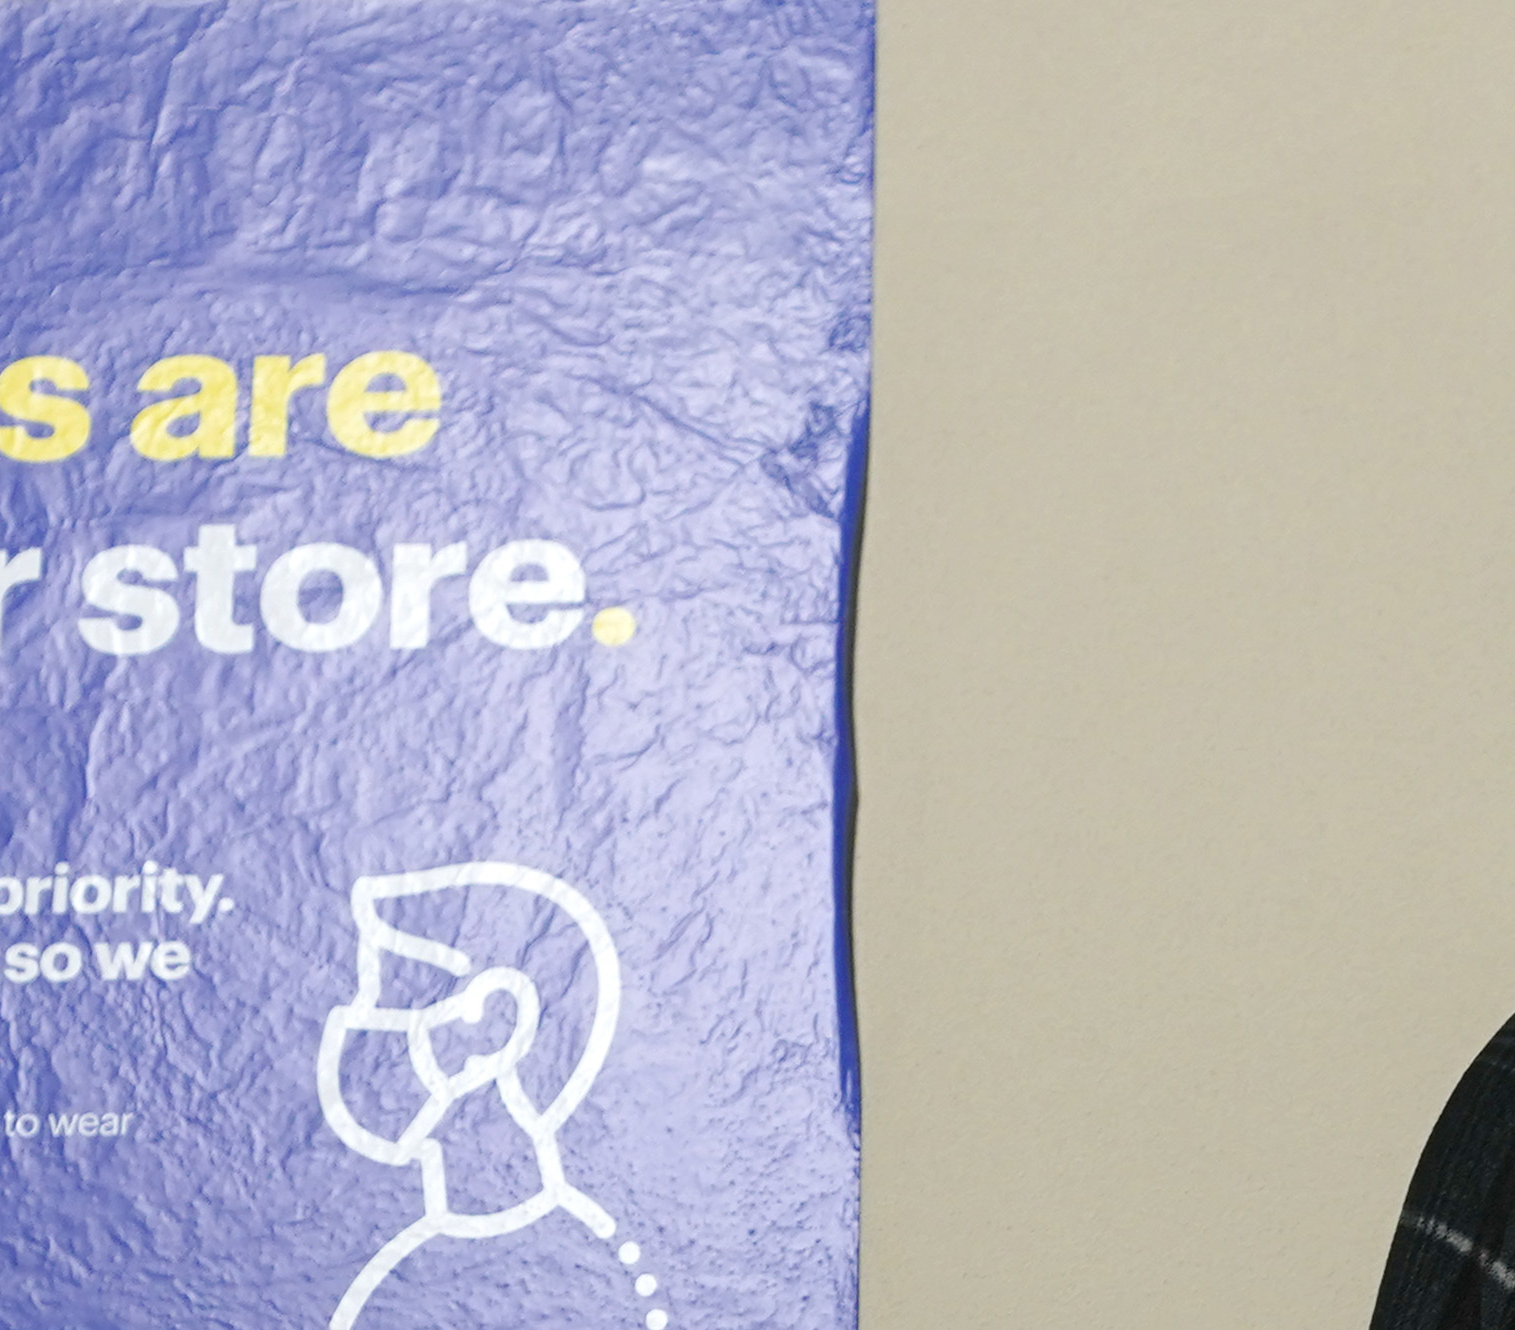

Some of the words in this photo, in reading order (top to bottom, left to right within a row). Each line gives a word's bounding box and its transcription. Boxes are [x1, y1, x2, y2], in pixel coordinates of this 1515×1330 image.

[129, 349, 443, 462] are
[76, 522, 638, 657] store.
[4, 941, 81, 983] so
[100, 937, 193, 981] we
[2, 1109, 41, 1139] to
[47, 1110, 136, 1138] wear
